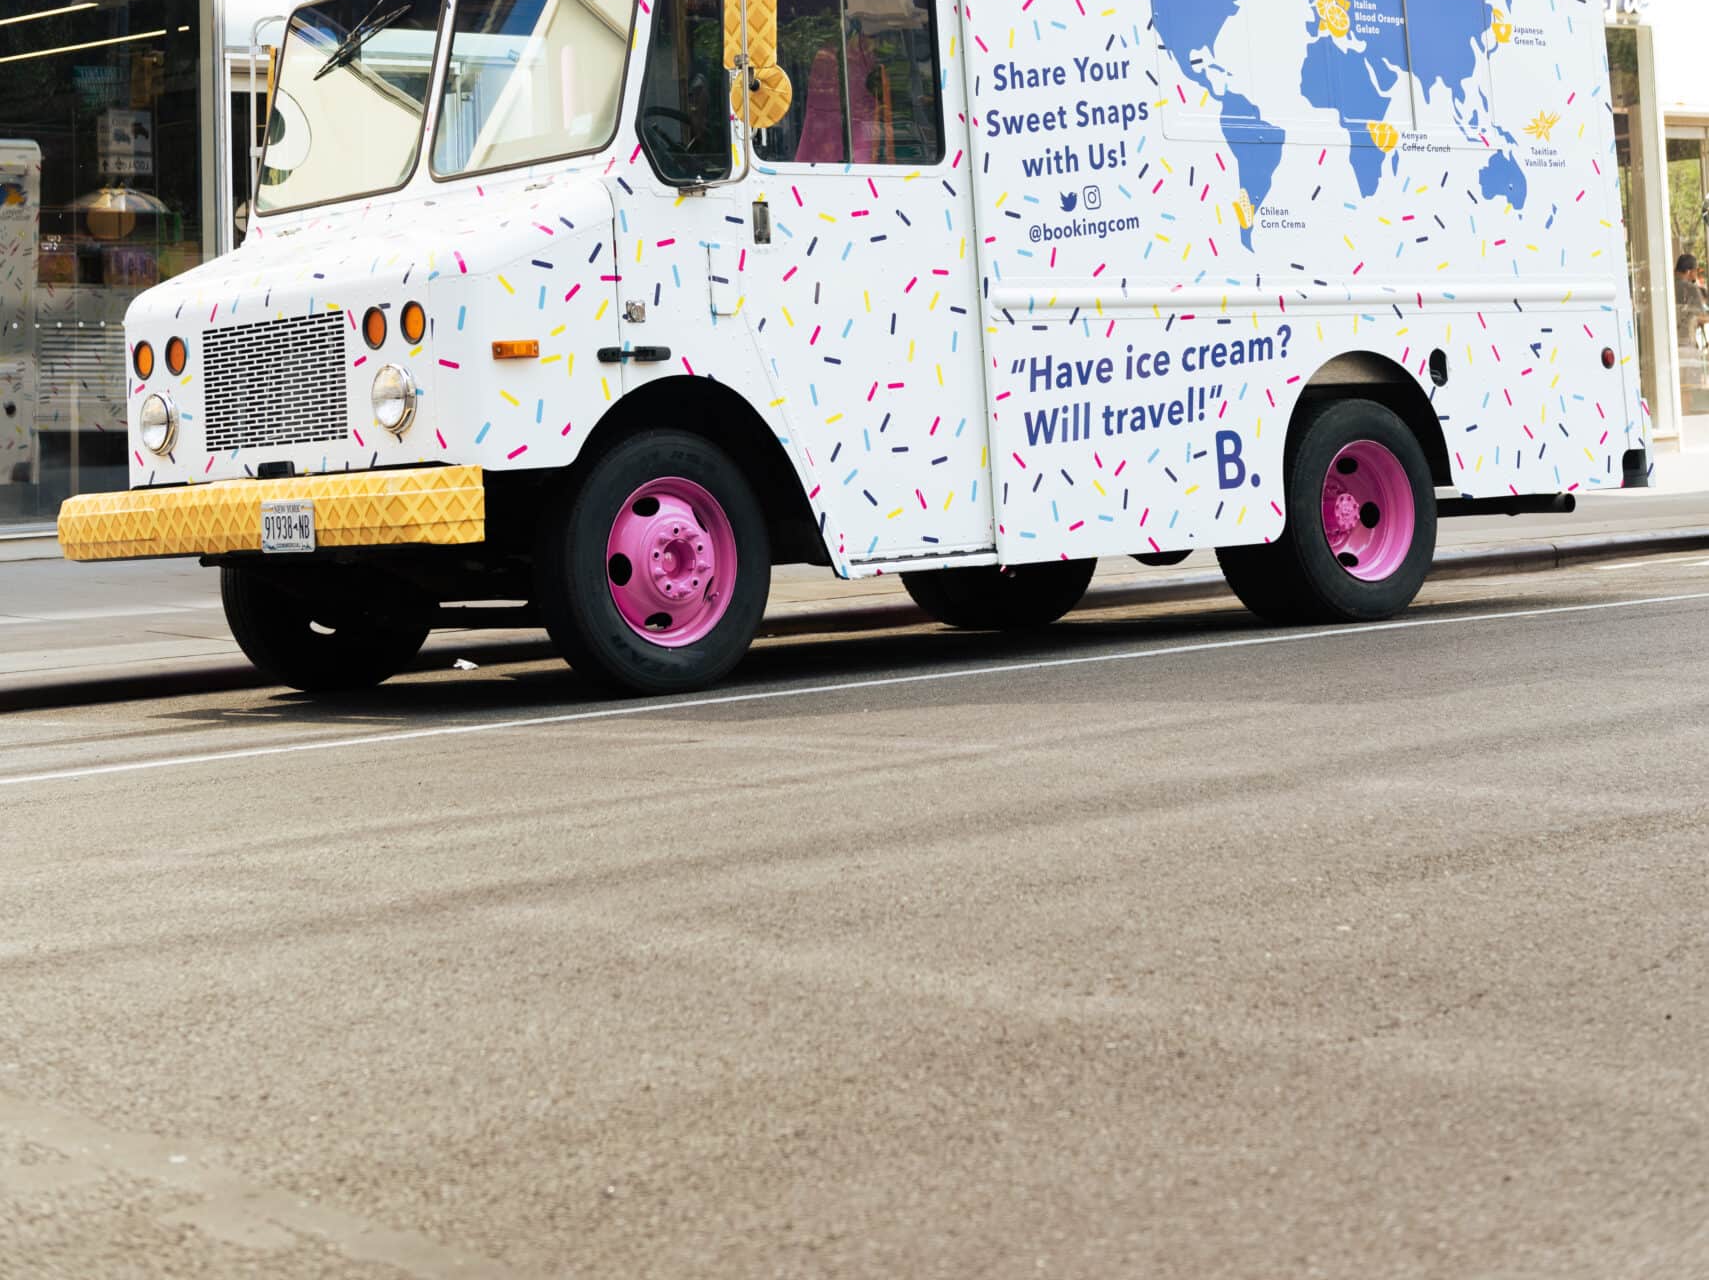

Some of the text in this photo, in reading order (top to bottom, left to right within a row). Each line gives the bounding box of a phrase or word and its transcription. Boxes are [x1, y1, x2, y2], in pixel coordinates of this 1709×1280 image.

[1353, 0, 1377, 10] Italian
[1354, 11, 1406, 27] Blood Orange
[1355, 23, 1380, 35] Gelato
[1513, 24, 1544, 37] Japanese
[1513, 36, 1547, 47] Green Tea
[993, 56, 1130, 91] Share Your
[986, 100, 1149, 137] Sweet Snaps
[1401, 130, 1428, 142] Kenyan
[1402, 142, 1451, 153] Coffee Crunch
[1022, 140, 1127, 178] with Us!
[1524, 157, 1567, 168] Vanilla Swirl
[1260, 206, 1289, 216] Chilean
[1029, 216, 1140, 243] @bookingcom
[1261, 219, 1306, 229] Corn Crema
[1126, 344, 1171, 381] ice
[1181, 324, 1292, 372] cream?
[1023, 401, 1091, 447] Will
[1215, 429, 1262, 490] B.
